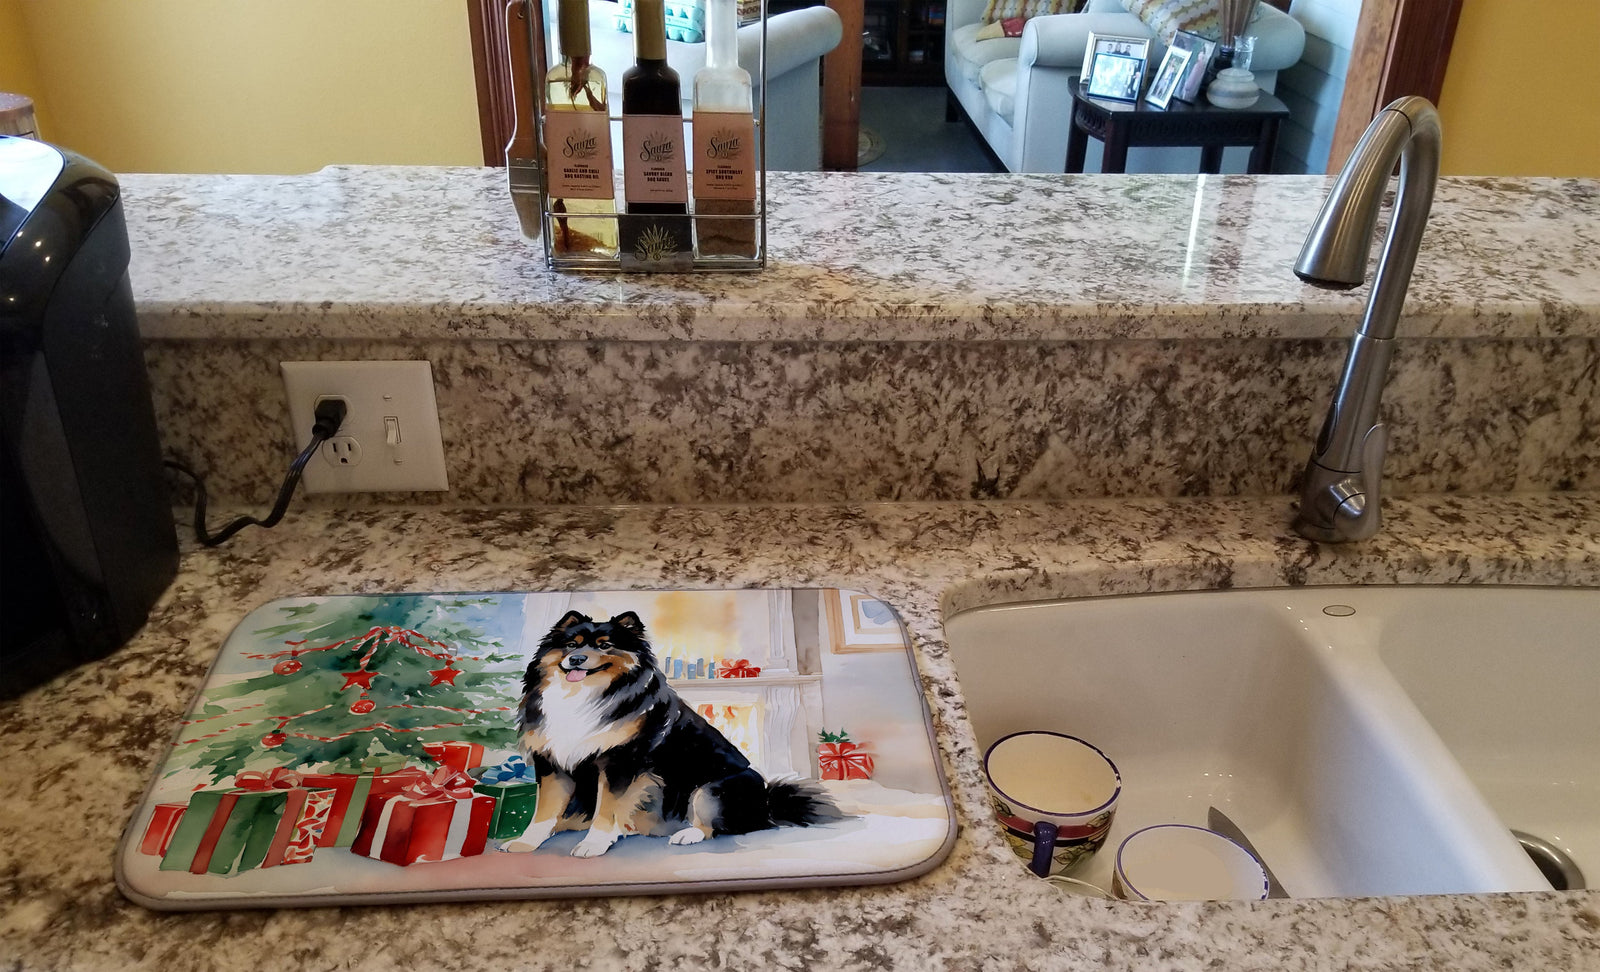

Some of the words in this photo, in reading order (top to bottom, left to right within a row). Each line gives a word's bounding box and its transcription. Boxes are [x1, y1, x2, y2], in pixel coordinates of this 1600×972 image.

[562, 136, 598, 158] Sauza
[639, 140, 673, 162] Sauza
[706, 136, 741, 159] Sauza
